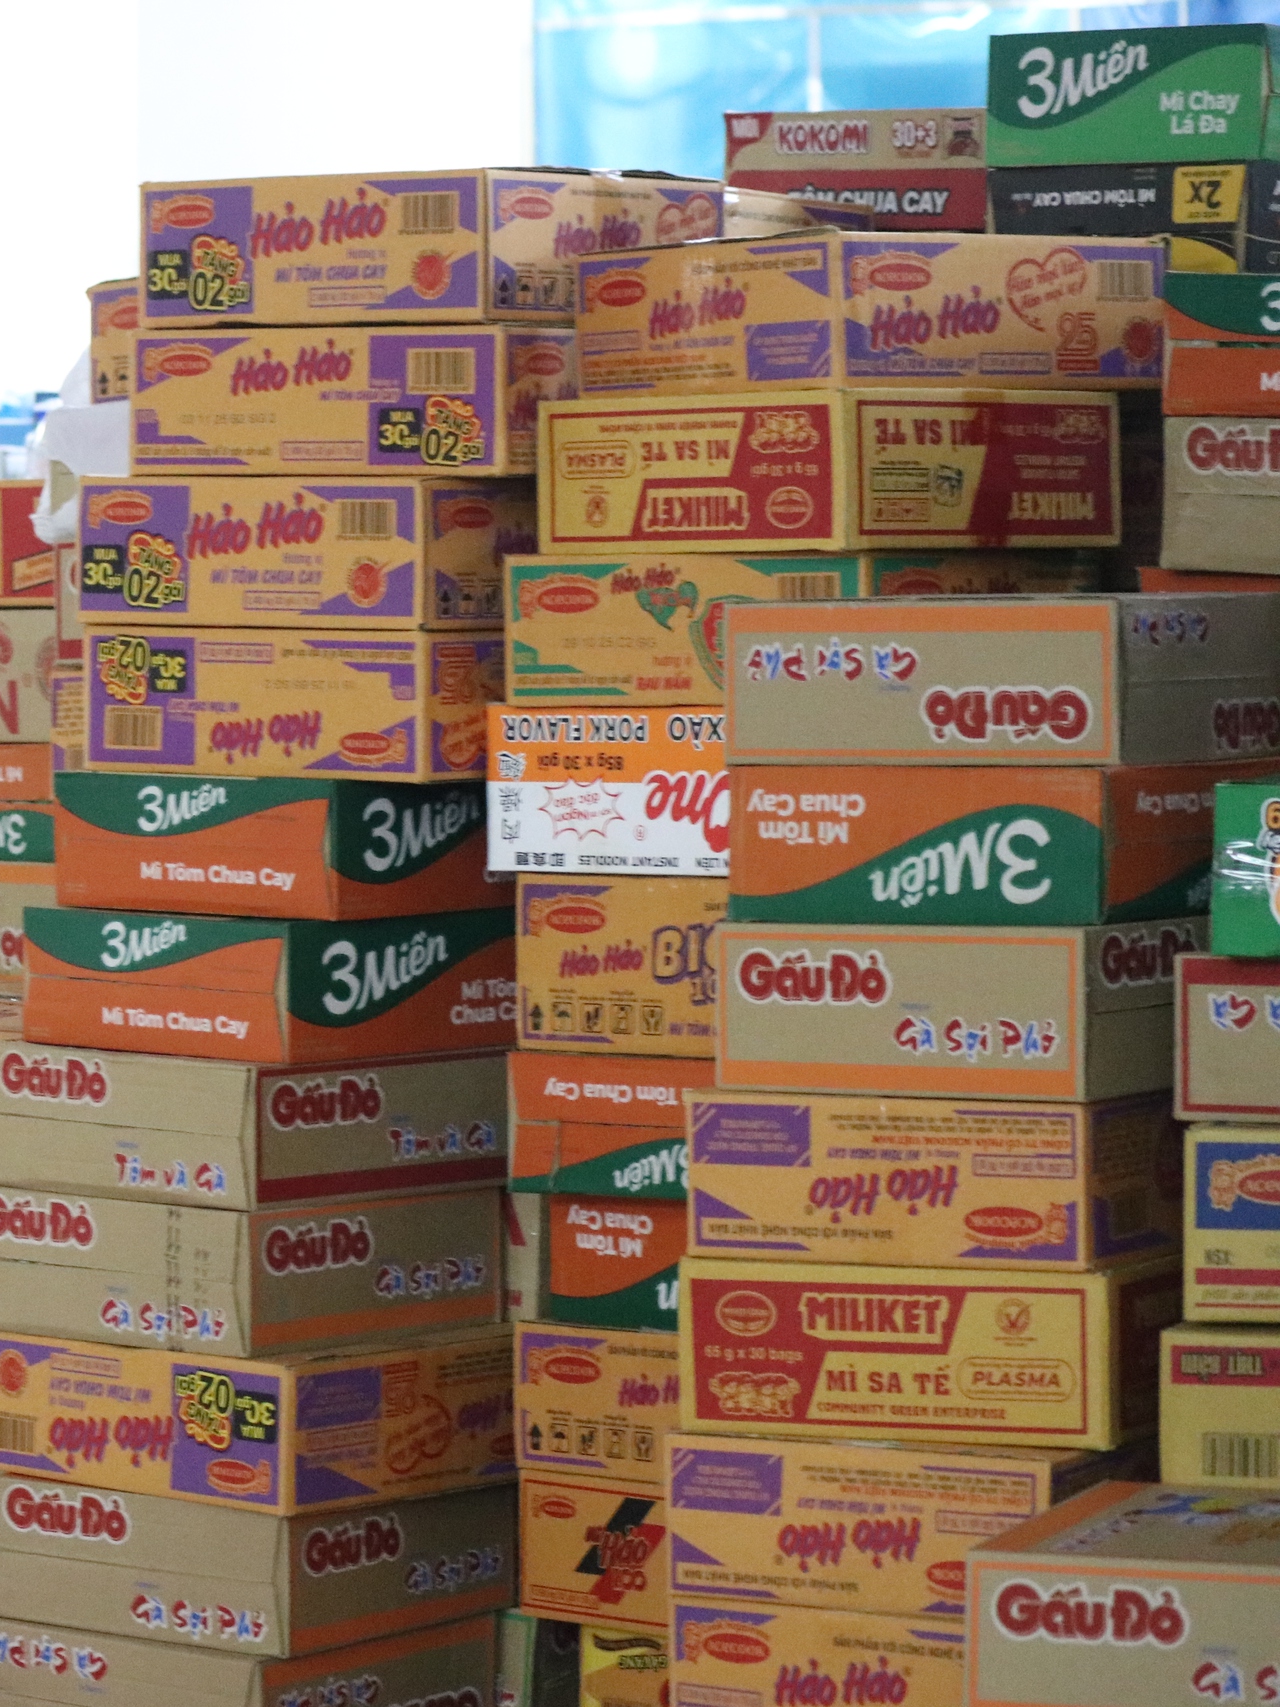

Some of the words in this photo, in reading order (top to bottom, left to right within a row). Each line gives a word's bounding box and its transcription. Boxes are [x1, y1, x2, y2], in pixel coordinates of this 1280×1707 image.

[1160, 92, 1184, 112] Mì
[1189, 90, 1239, 114] Chay
[777, 122, 868, 153] KOKOMI
[1172, 116, 1194, 134] Lá
[1199, 115, 1227, 133] Đa
[902, 190, 950, 213] CAY
[249, 202, 314, 258] Hảo
[320, 188, 388, 245] Hảo
[871, 295, 932, 351] Hảo
[936, 285, 1001, 339] Hảo
[231, 349, 288, 395] Hảo
[294, 339, 352, 386] Hảo
[566, 453, 626, 468] PLASMA
[641, 442, 667, 470] TẾ
[674, 441, 699, 459] SA
[707, 439, 731, 467] MÌ
[188, 504, 251, 559] Hảo
[257, 492, 325, 550] Hảo
[646, 496, 745, 530] MILIKET
[123, 568, 162, 606] 02
[501, 716, 585, 743] FLAVOR
[589, 716, 650, 743] PORK
[668, 715, 726, 750] XÀO
[748, 789, 795, 814] Cay
[800, 794, 865, 816] Chua
[759, 822, 819, 844] Tôm
[824, 822, 850, 844] Mì
[578, 855, 628, 866] NOODLES
[631, 856, 679, 867] INSTANT
[140, 862, 161, 880] Mì
[164, 862, 205, 883] Tôm
[208, 865, 256, 886] Chua
[259, 867, 296, 890] Cay
[102, 1008, 123, 1026] Mì
[126, 1008, 168, 1030] Tôm
[171, 1011, 212, 1033] Chua
[215, 1016, 249, 1038] Cay
[895, 1017, 936, 1052] Gà
[946, 1017, 991, 1060] Sợi
[1000, 1019, 1056, 1056] Phở
[544, 1077, 579, 1100] Cay
[584, 1084, 632, 1103] Chua
[636, 1087, 679, 1105] Tôm
[115, 1152, 156, 1185] Tôm
[164, 1165, 187, 1189] và
[195, 1163, 226, 1193] Gà
[810, 1175, 881, 1224] Hảo
[886, 1166, 958, 1217] Hảo
[567, 1206, 600, 1227] Cay
[604, 1213, 653, 1235] Chua
[576, 1234, 617, 1257] Tôm
[620, 1238, 644, 1258] Mì
[803, 1295, 947, 1337] MILIKET
[737, 1351, 746, 1361] x
[826, 1362, 857, 1393] MÌ
[868, 1371, 901, 1395] SA
[913, 1365, 950, 1396] TẾ
[971, 1370, 1063, 1390] PLASMA
[50, 1416, 109, 1468] Hảo
[114, 1415, 173, 1468] Hảo
[778, 1523, 846, 1573] Hảo
[853, 1518, 920, 1568] Hảo
[131, 1595, 165, 1627] Gà
[218, 1606, 268, 1642] Phở
[775, 1659, 838, 1707] Hảo
[842, 1656, 908, 1706] Hảo
